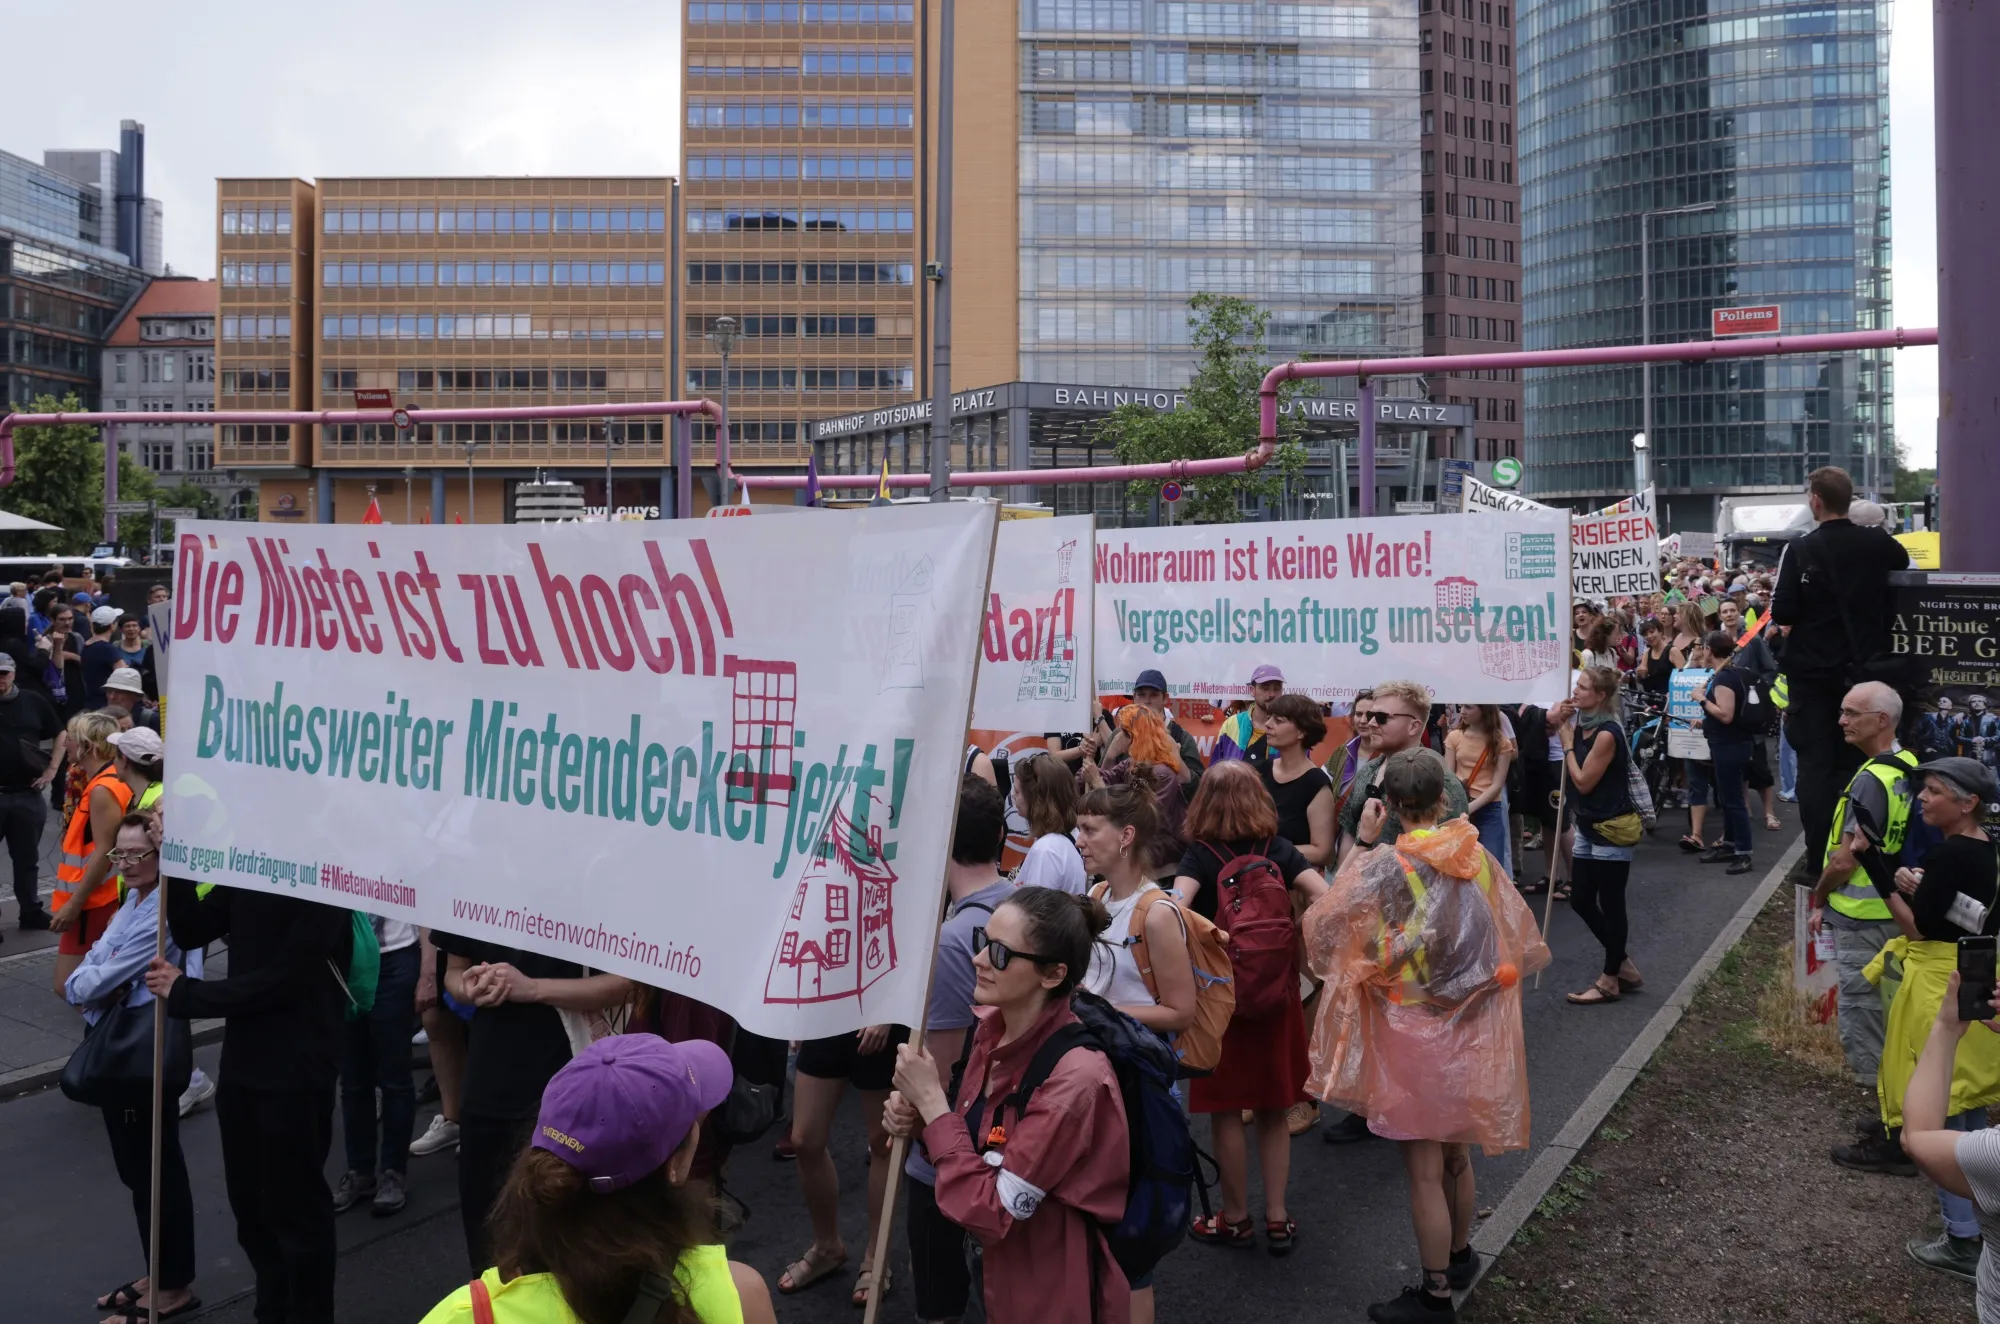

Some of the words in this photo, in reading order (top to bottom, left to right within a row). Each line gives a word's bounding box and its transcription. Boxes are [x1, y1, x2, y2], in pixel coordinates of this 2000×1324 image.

[1718, 309, 1774, 322] Pollems
[1055, 388, 1186, 409] BAHNHOF
[819, 415, 865, 436] BAHNHOF
[873, 402, 933, 426] POTSDAME
[952, 390, 996, 412] PLATZ
[1380, 404, 1447, 421] PLATZ
[1495, 458, 1518, 486] S
[616, 505, 660, 518] GUYS
[1095, 541, 1215, 584] Wohnraum
[1224, 538, 1259, 582] ist
[1266, 535, 1338, 581] keine
[1346, 529, 1432, 579] Ware!
[174, 533, 244, 645] Die
[246, 536, 384, 655] Miete
[367, 540, 464, 664] ist
[457, 574, 545, 668] zu
[526, 538, 738, 678] hoch!
[1919, 601, 1960, 610] NIGHTS
[1963, 602, 1980, 610] ON
[1113, 596, 1379, 655] Vergesellschaftung
[1388, 591, 1558, 644] umsetzen!
[1890, 613, 1909, 632] A
[1912, 614, 1989, 635] Tribute
[1890, 633, 1959, 657] BEE
[1098, 678, 1124, 691] Bündnis
[1178, 682, 1191, 694] und
[196, 674, 454, 791] Bundesweiter
[463, 698, 773, 845] Mietendeckel
[162, 836, 188, 864] ündnis
[189, 845, 224, 874] gegen
[228, 845, 297, 888] Verdrängung
[299, 861, 317, 886] und
[320, 862, 416, 908] #Mietenwahnsinn
[452, 897, 702, 979] www.mietenwahnsinn.info
